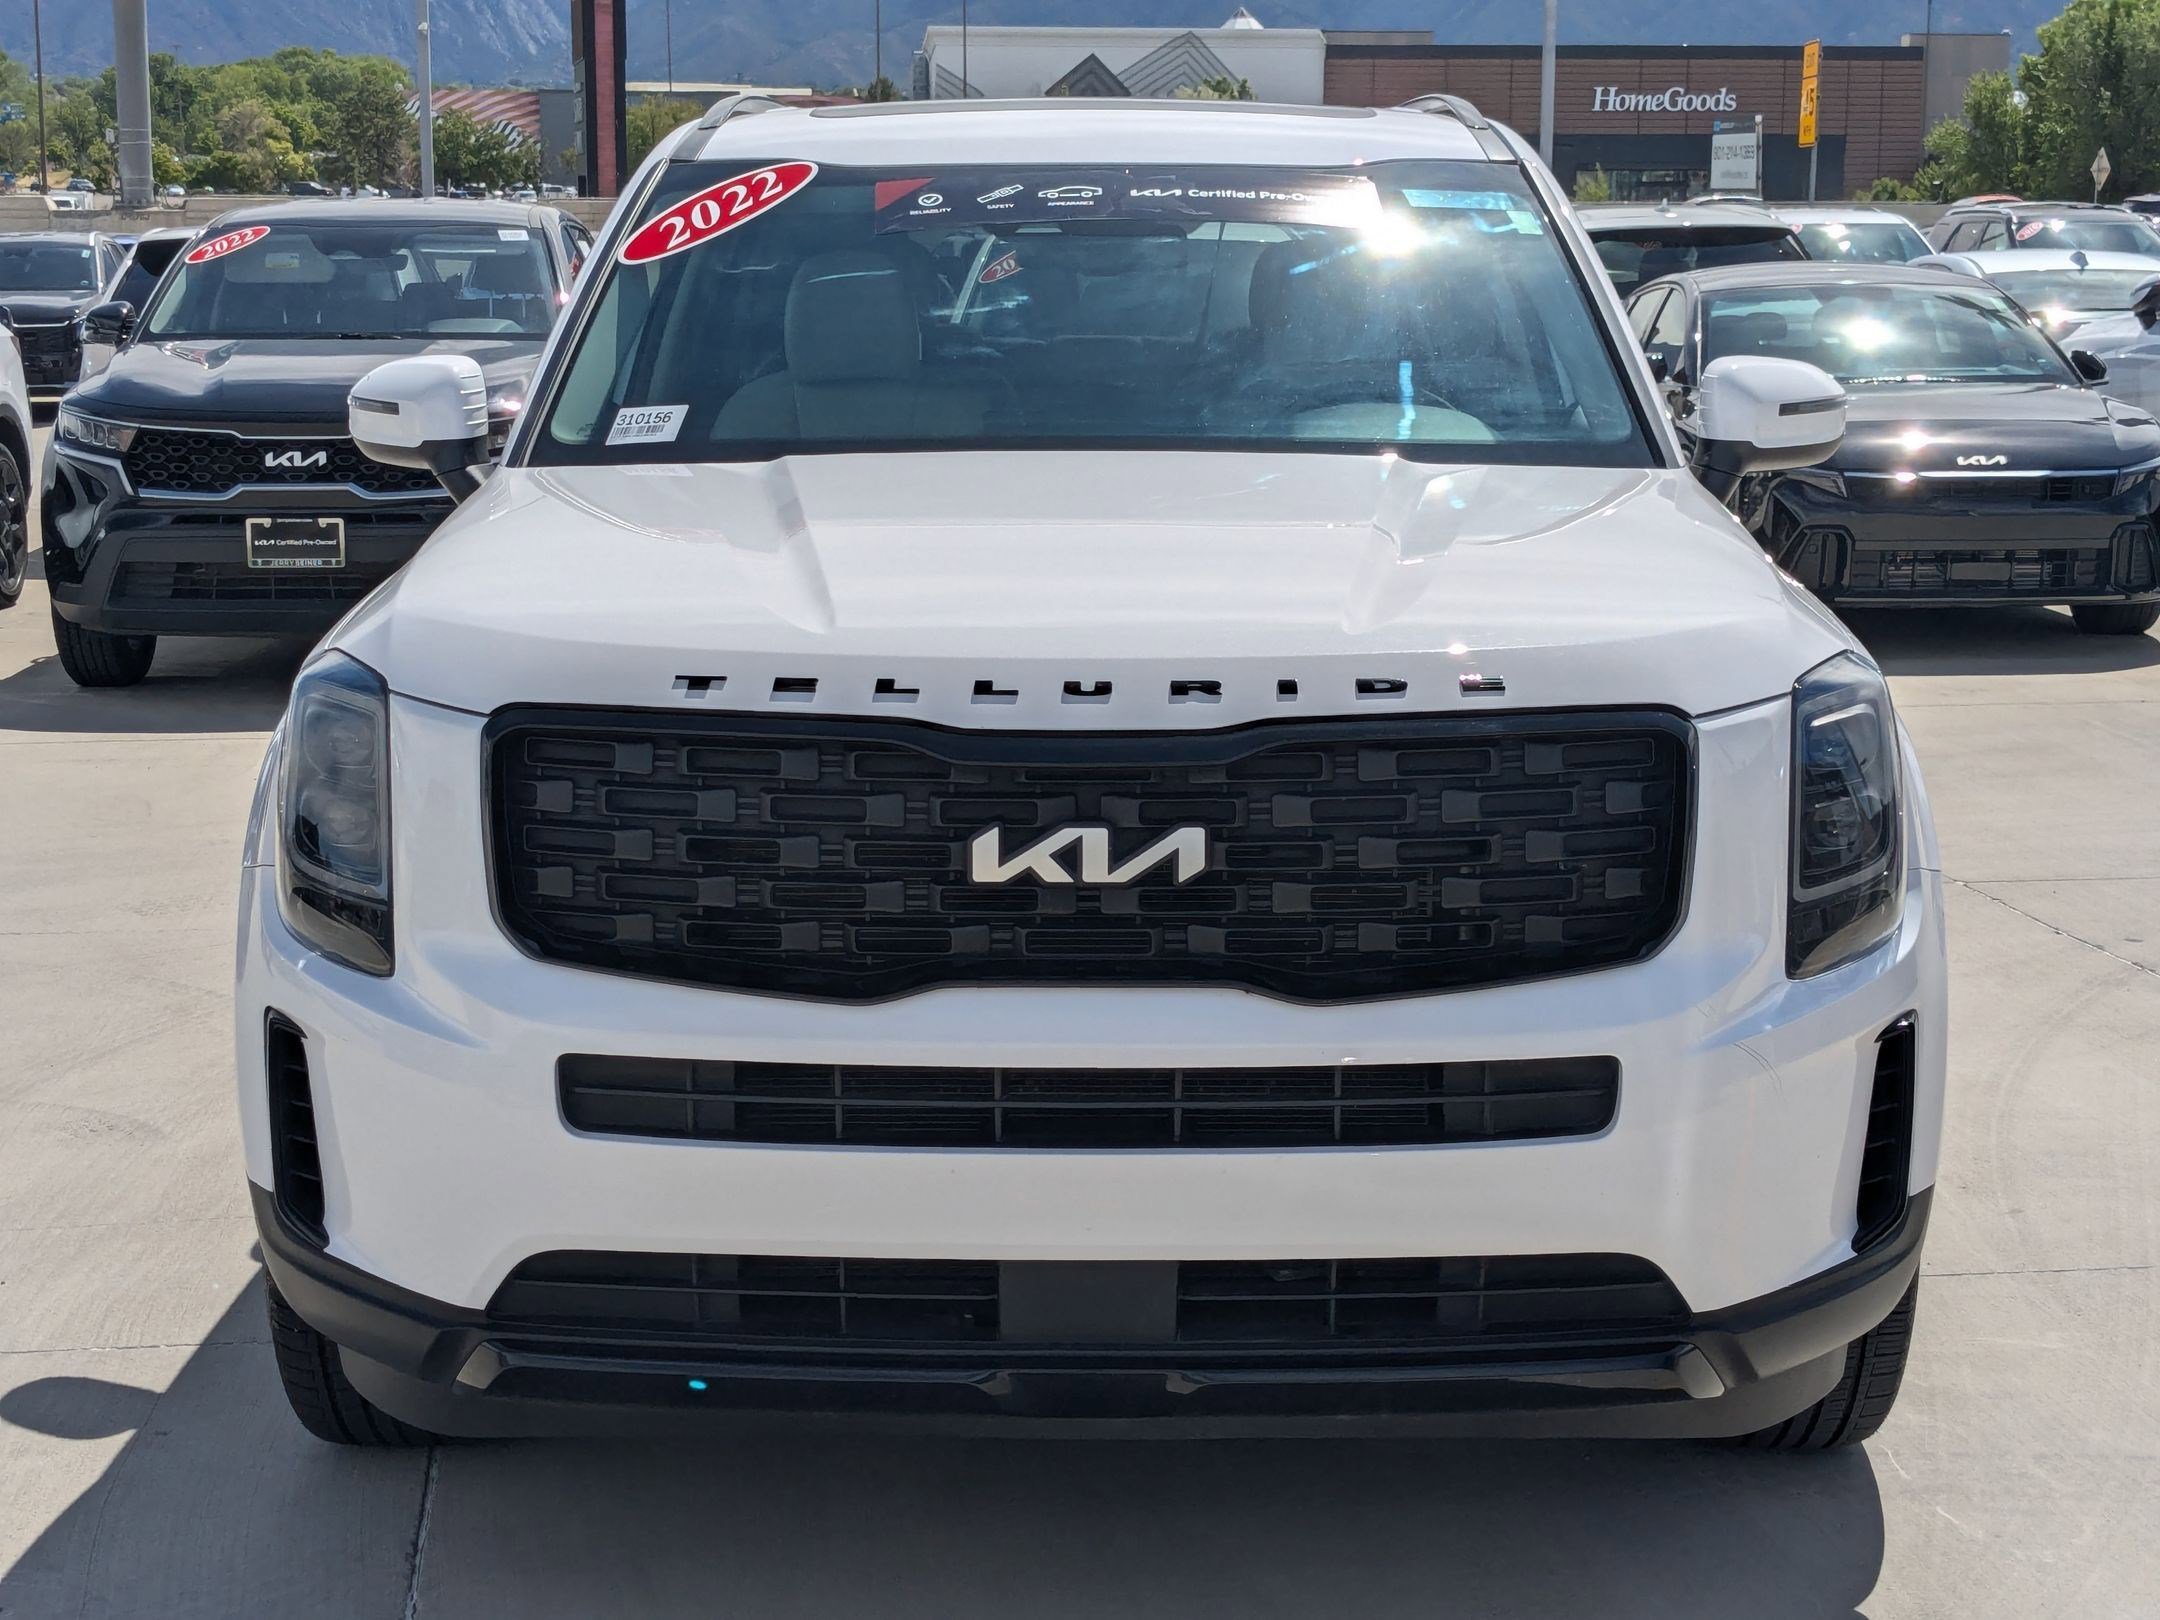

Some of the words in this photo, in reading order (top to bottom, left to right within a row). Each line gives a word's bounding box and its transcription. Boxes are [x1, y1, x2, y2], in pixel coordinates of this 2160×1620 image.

[1592, 86, 1737, 112] HomeGoods
[1130, 188, 1182, 197] KIA
[1187, 188, 1256, 199] Certified
[660, 171, 783, 250] 2022
[909, 207, 952, 216] RELIABILITY
[202, 230, 255, 259] 2022
[616, 411, 674, 426] 310156
[265, 450, 327, 467] KIA
[1956, 455, 2008, 466] KIA
[672, 674, 1506, 702] TELLURIDE
[971, 826, 1206, 884] KIA
